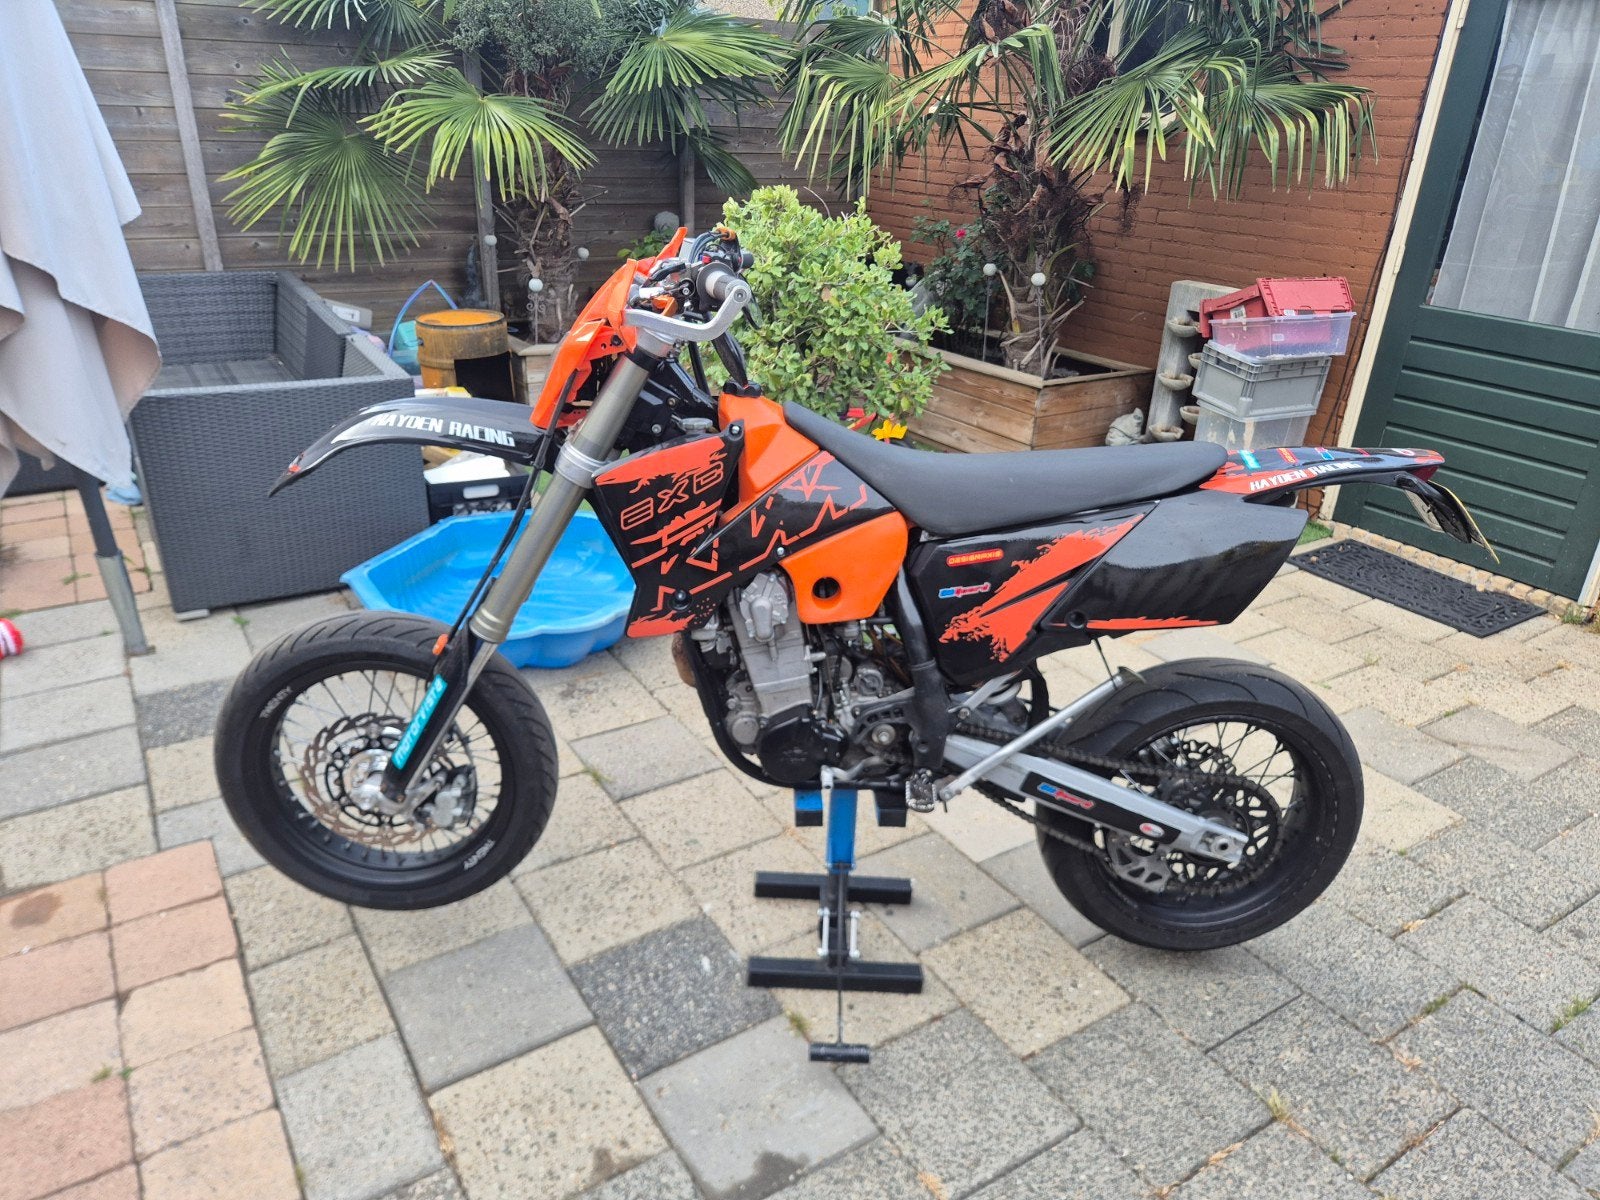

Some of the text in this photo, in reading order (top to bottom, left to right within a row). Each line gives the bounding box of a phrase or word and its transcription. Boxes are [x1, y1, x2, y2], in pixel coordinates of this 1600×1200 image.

[370, 414, 516, 447] HAYDEN RACING
[1250, 469, 1307, 492] HAYDEN
